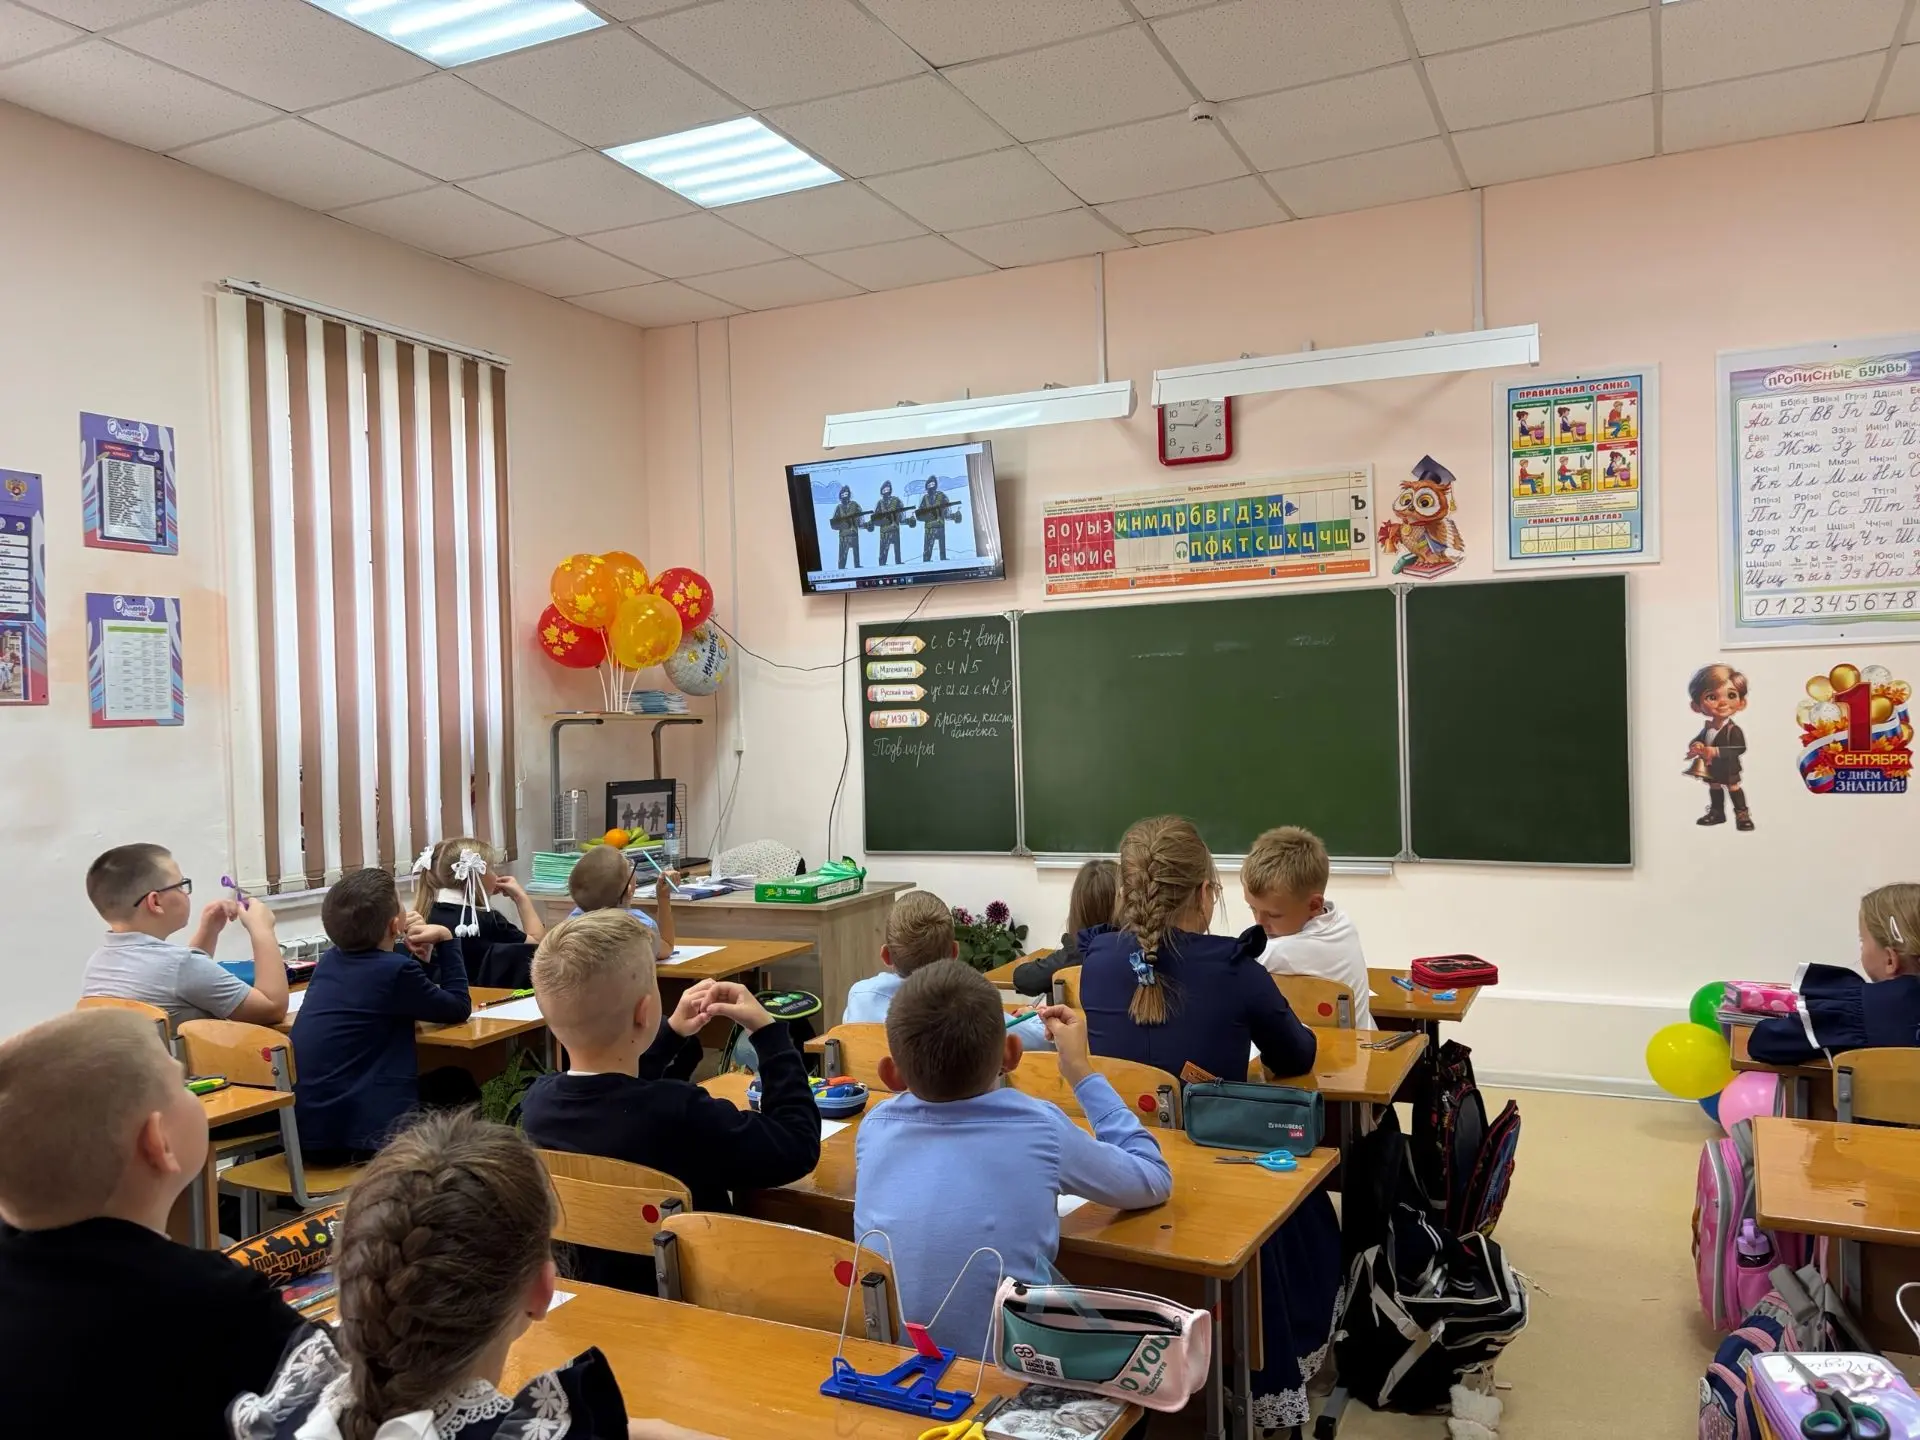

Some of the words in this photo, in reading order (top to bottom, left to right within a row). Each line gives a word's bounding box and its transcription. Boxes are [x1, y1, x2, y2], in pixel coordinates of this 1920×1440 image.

[1768, 369, 1852, 386] ПРОПИСНЫЕ
[1859, 363, 1907, 377] БУКВЫ
[1519, 385, 1585, 399] ПРАВИЛЬНАЯ
[1589, 381, 1631, 392] ОСАНКА
[1214, 404, 1222, 413] 2
[1169, 410, 1178, 418] 10
[1215, 419, 1222, 427] 3
[1169, 424, 1176, 432] 9
[1169, 438, 1176, 447] 8
[1179, 446, 1185, 454] 7
[1192, 444, 1199, 453] 6
[1205, 444, 1212, 452] 5
[1528, 516, 1580, 524] ГИМНАСТИКА
[880, 666, 913, 674] Математика
[880, 688, 901, 697] Русский
[891, 715, 908, 723] ИЗО
[1832, 682, 1872, 752] 1
[1835, 754, 1908, 766] СЕНТЯБРЯ
[1837, 771, 1845, 780] С
[1847, 769, 1881, 780] ДНЁМ
[1836, 779, 1906, 792] ЗНАНИЙ!
[254, 1252, 278, 1271] ПОЛ
[280, 1250, 300, 1269] ЭТО
